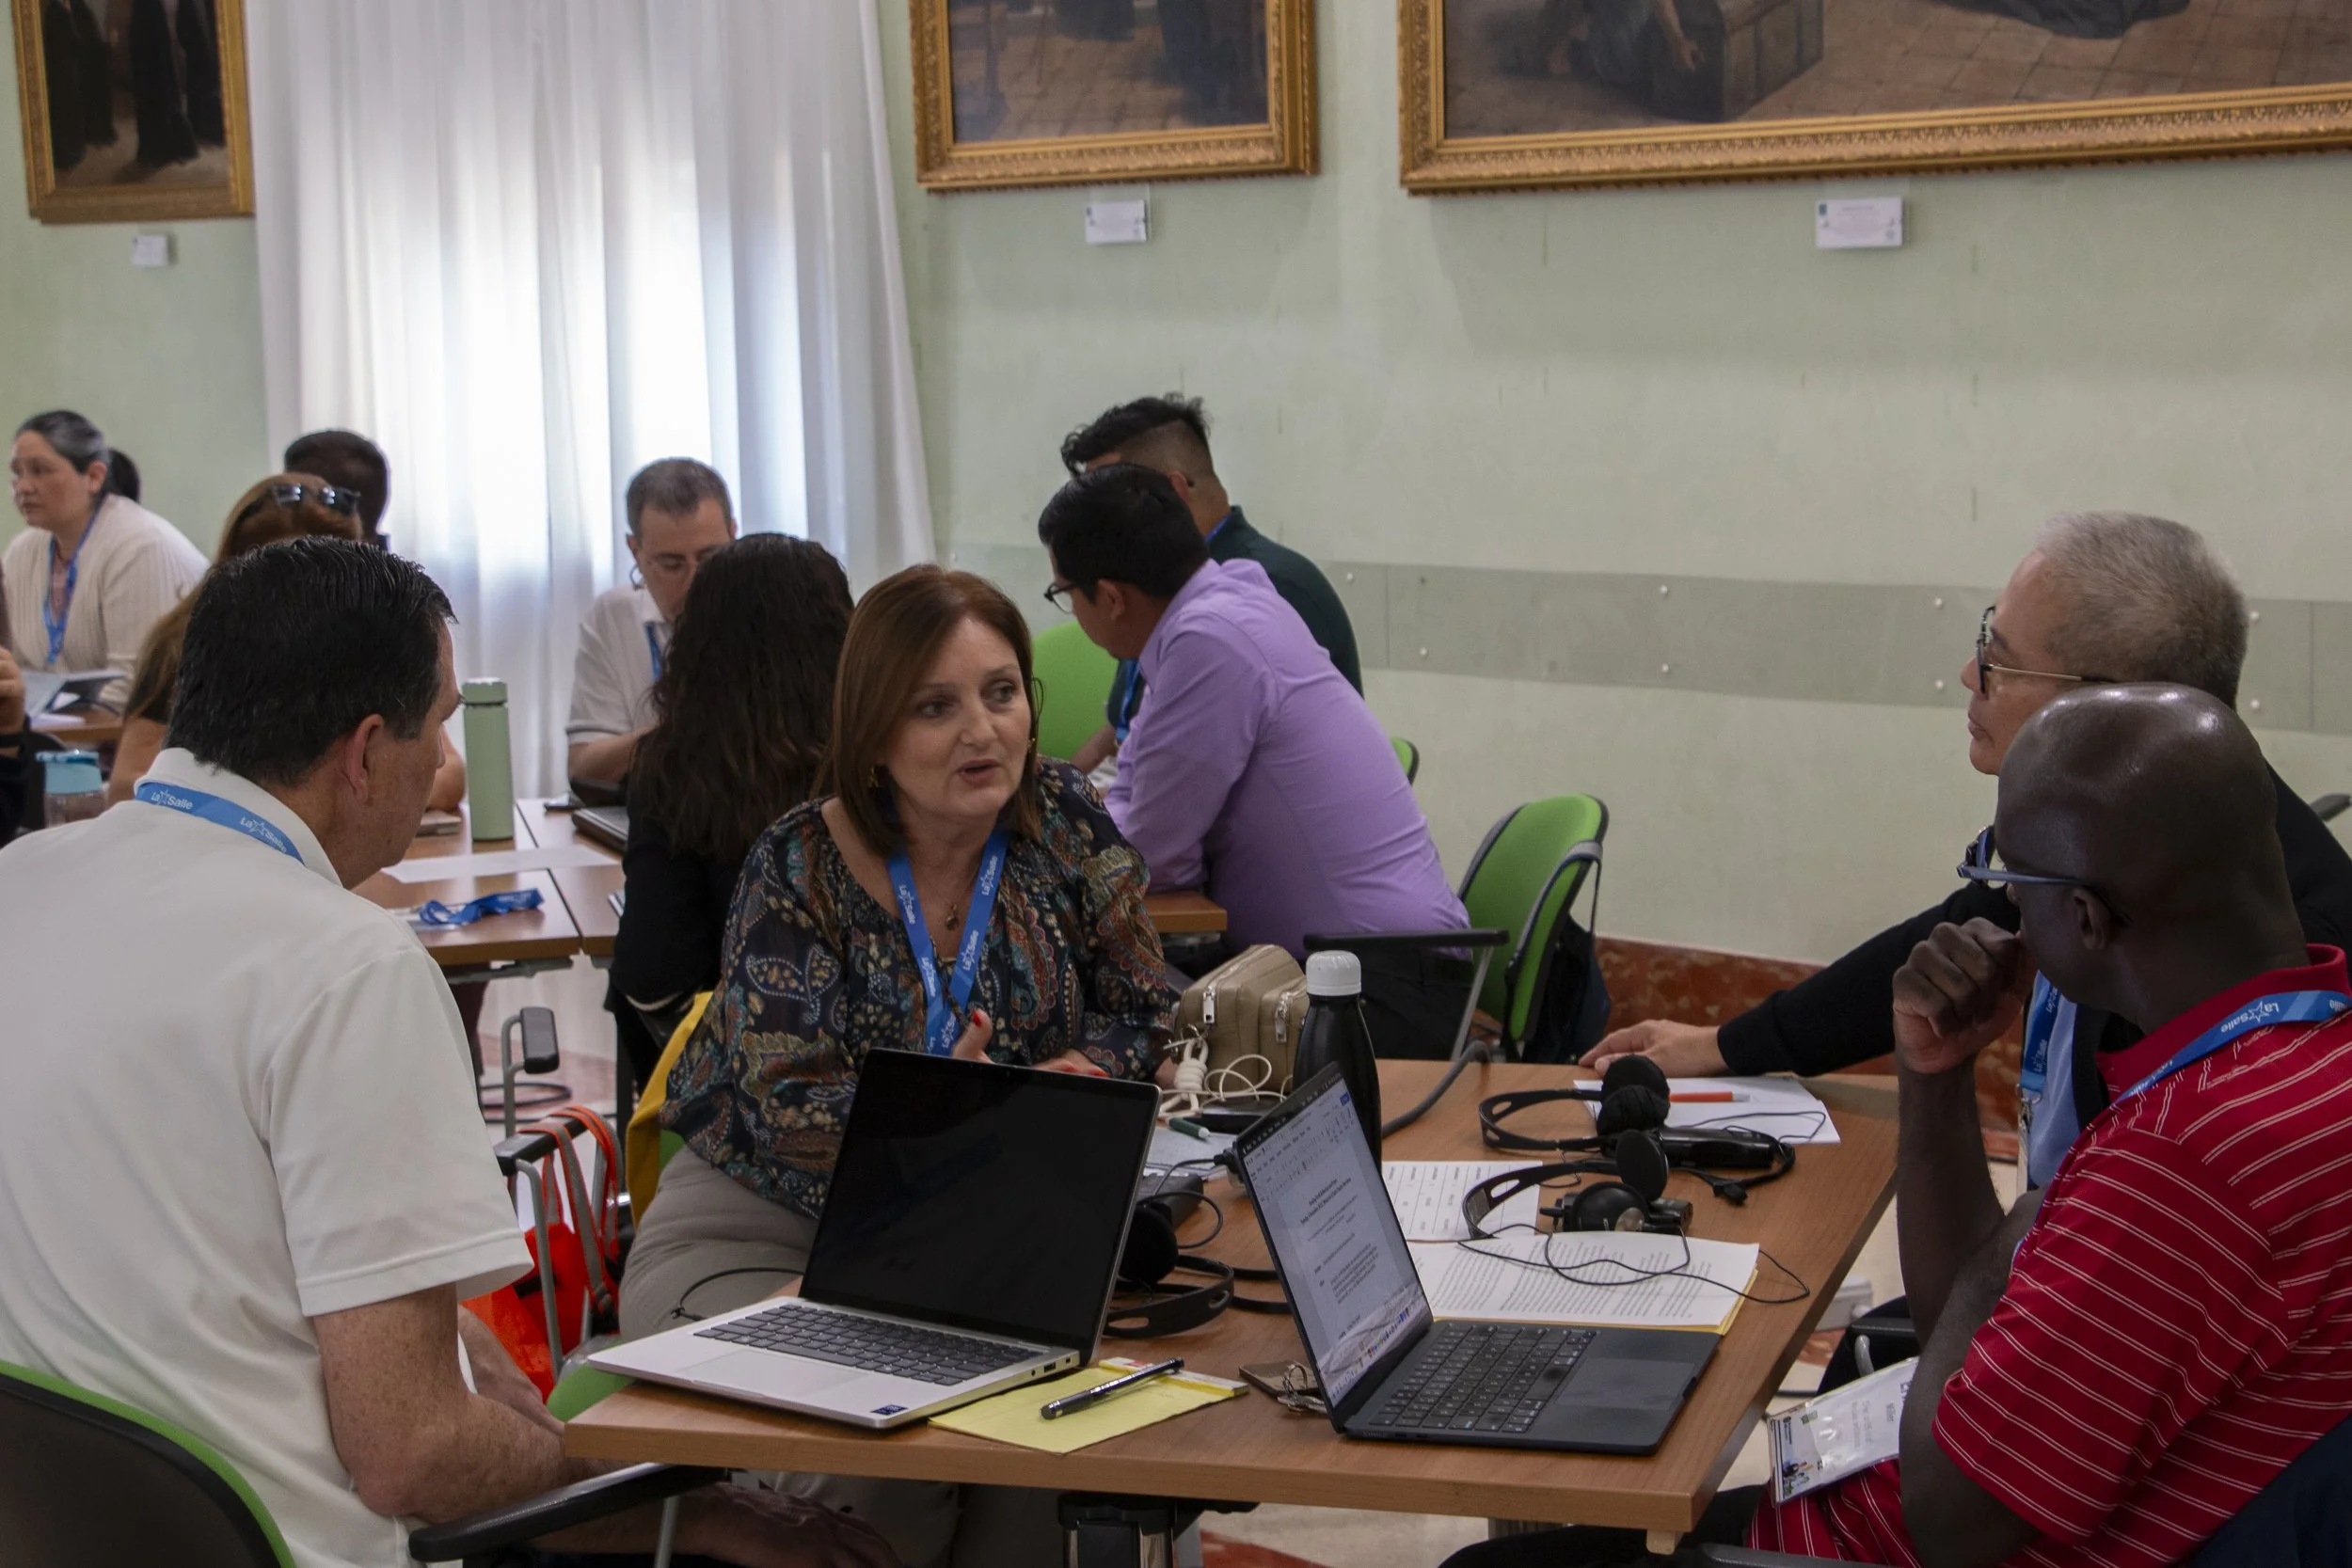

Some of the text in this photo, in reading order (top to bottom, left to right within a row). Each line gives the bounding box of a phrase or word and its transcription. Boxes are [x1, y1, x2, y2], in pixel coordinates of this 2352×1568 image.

[167, 796, 194, 810] Salle
[240, 816, 253, 829] La
[2221, 1003, 2280, 1033] La Salle
